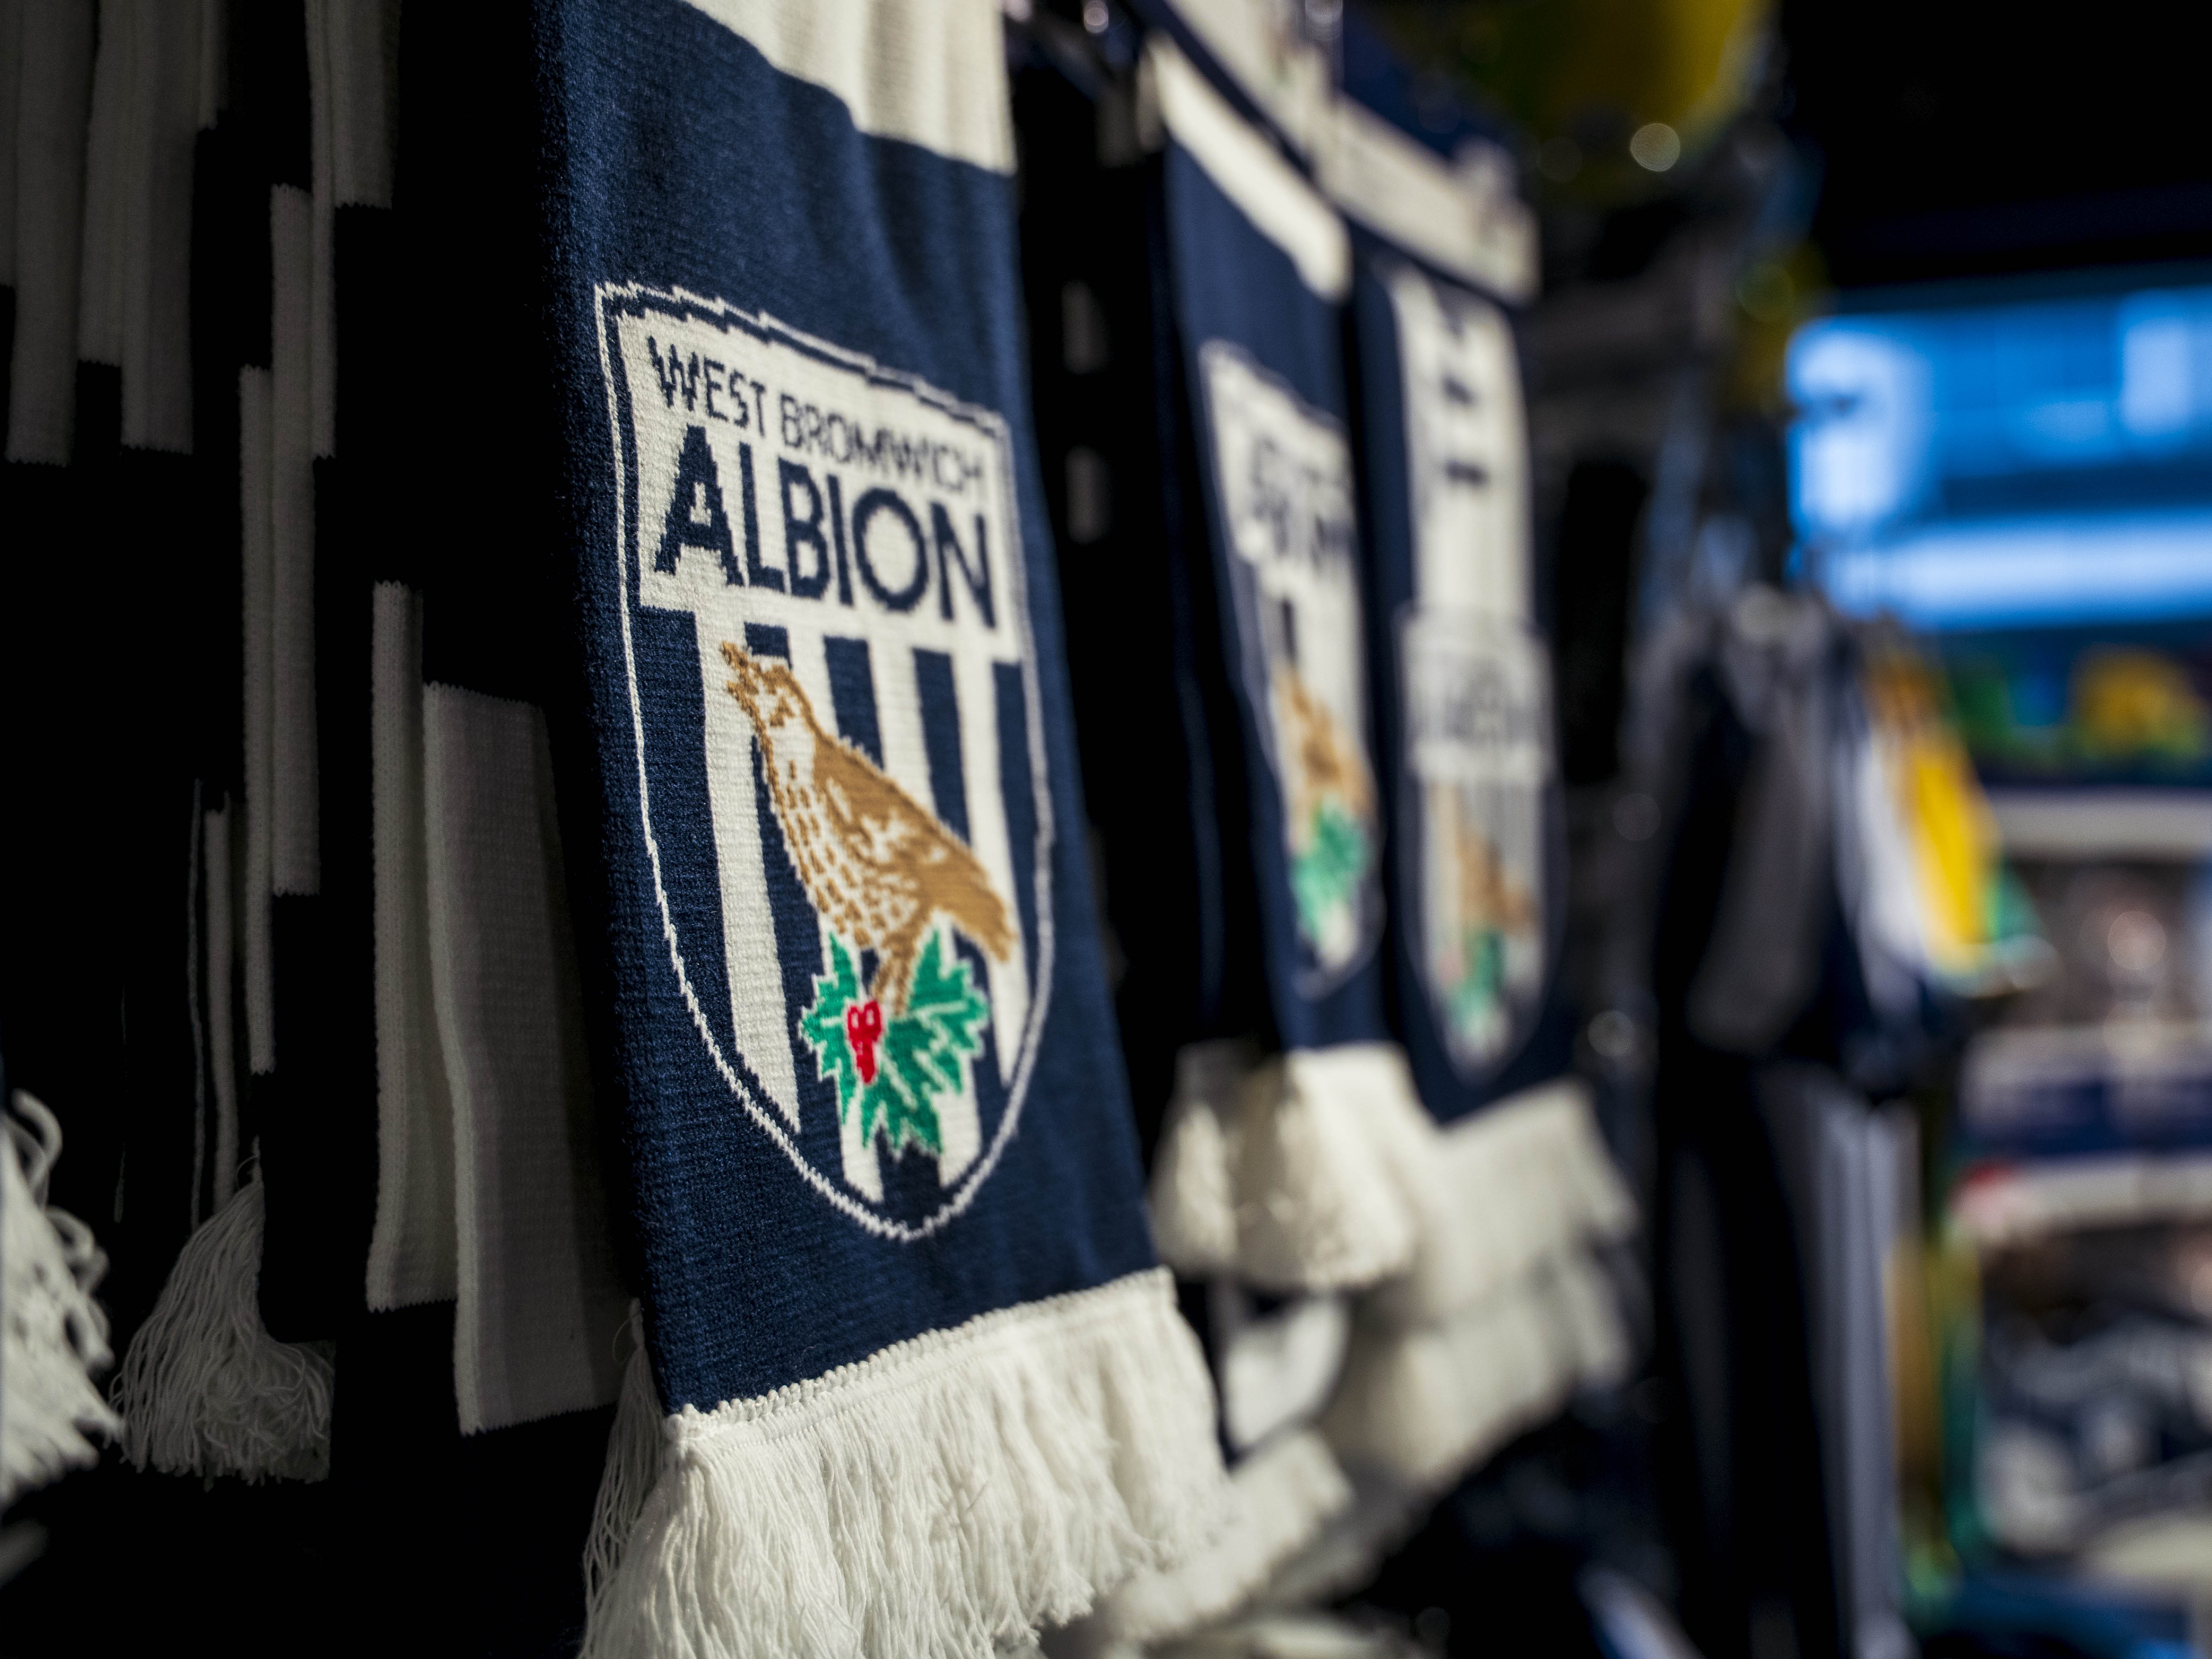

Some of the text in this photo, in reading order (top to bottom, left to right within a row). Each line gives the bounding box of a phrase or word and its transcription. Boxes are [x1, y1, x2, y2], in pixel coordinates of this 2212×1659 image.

[648, 335, 983, 492] WEST BROMWICH
[655, 424, 996, 628] ALBION
